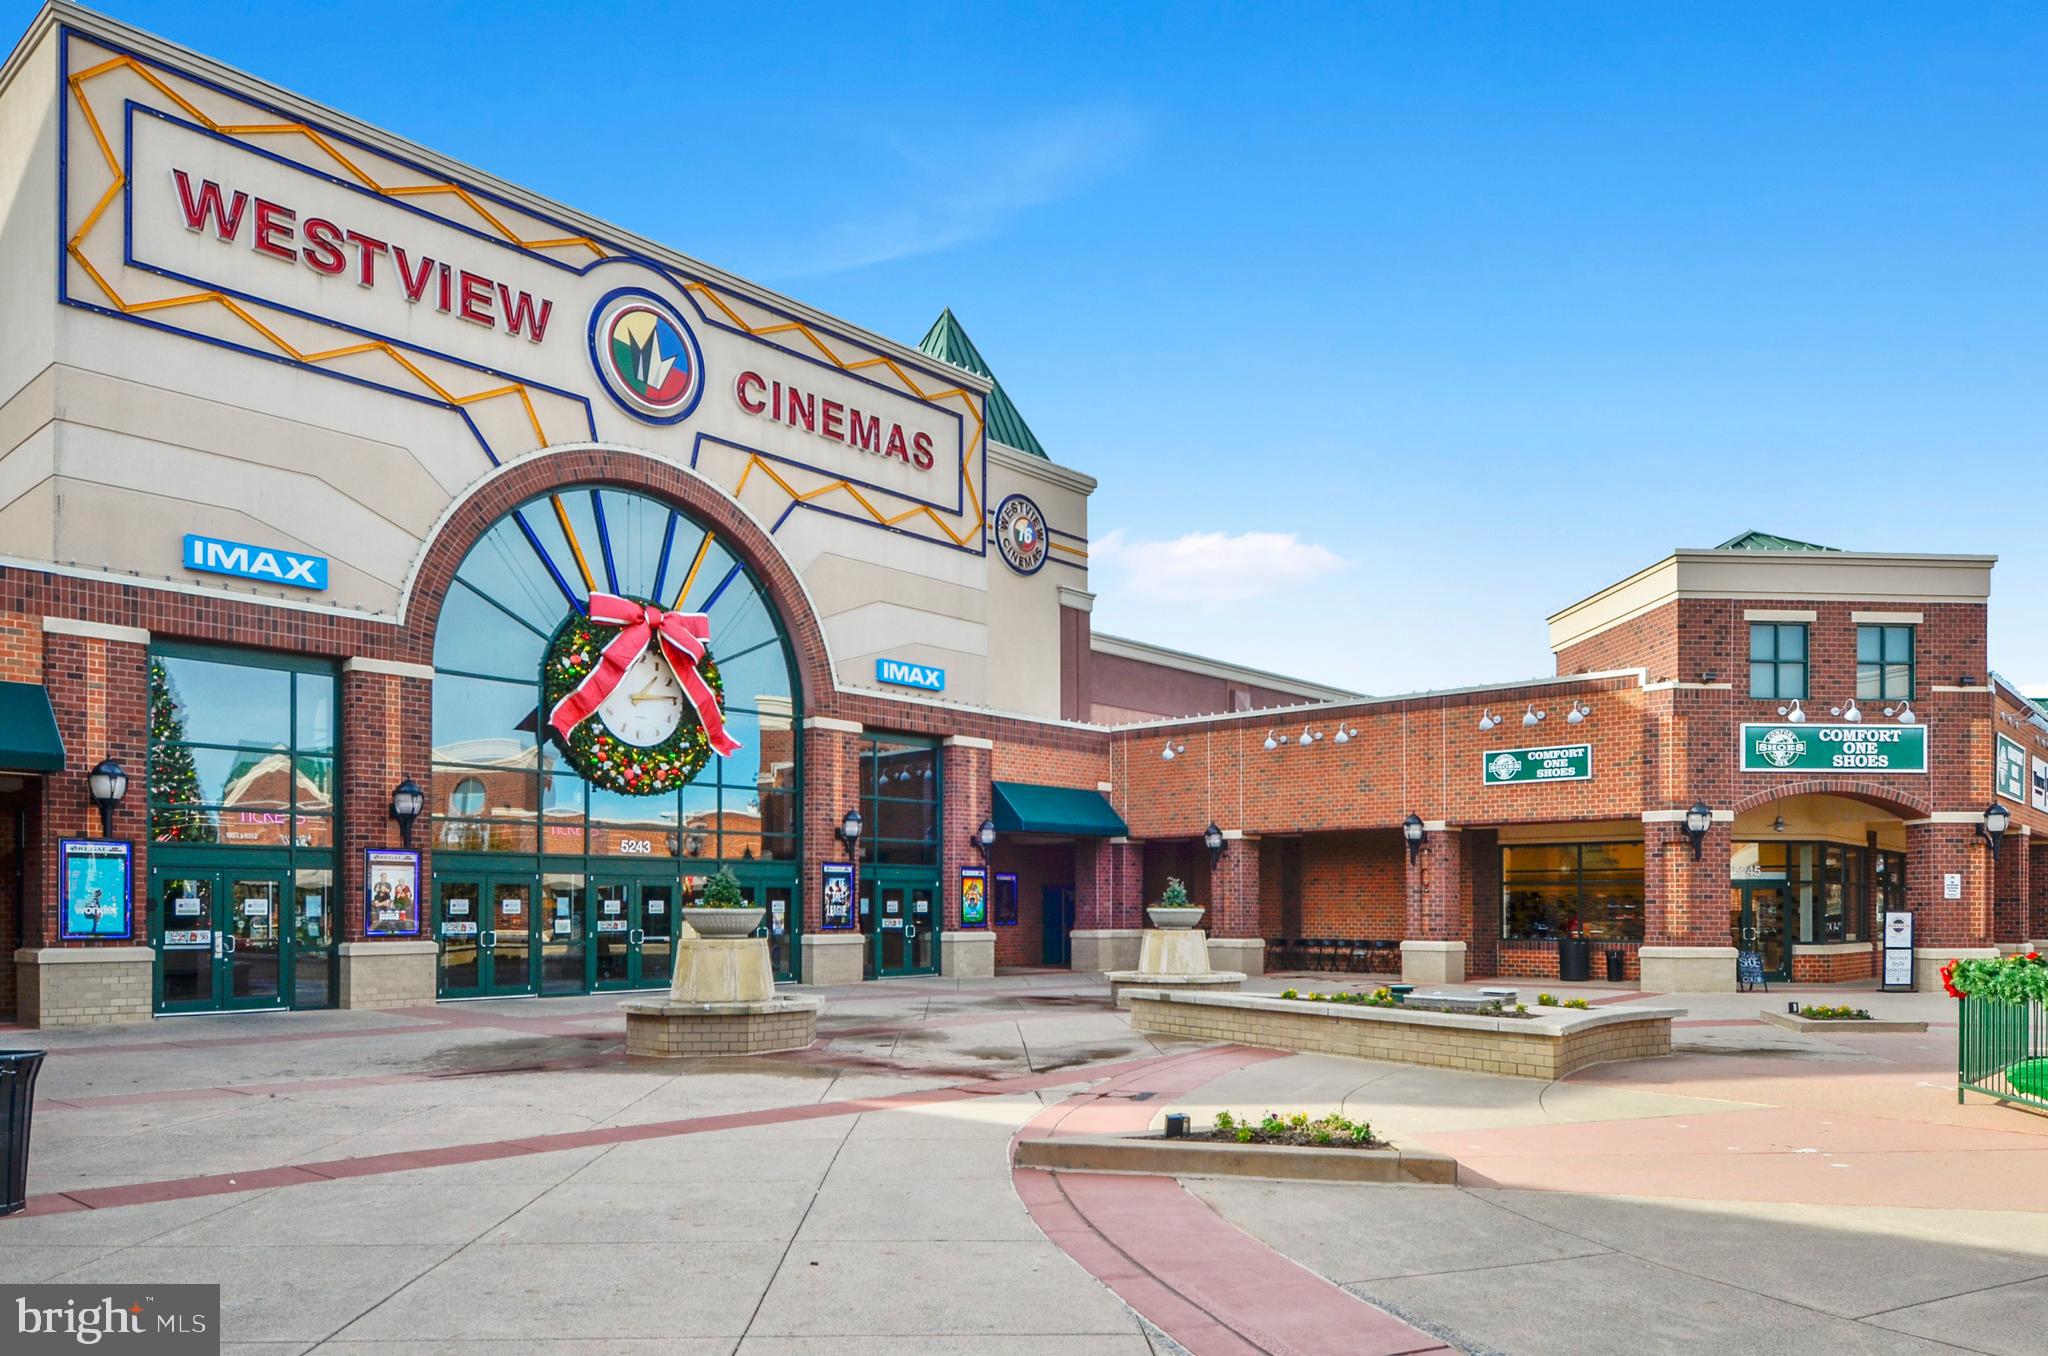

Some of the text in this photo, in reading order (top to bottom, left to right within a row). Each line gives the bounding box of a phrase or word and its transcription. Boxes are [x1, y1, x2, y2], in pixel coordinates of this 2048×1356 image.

[172, 168, 553, 343] WESTVIEW
[735, 371, 934, 471] CINEMAS
[1001, 501, 1044, 541] WESTVIEW
[1019, 526, 1033, 544] 16
[1002, 538, 1042, 568] CINEMAS
[194, 540, 317, 584] IMAX
[883, 661, 940, 687] IMAX
[1819, 729, 1901, 742] COMFORT
[1758, 743, 1805, 752] SHOES
[1842, 742, 1878, 754] ONE
[1527, 748, 1585, 761] COMFORT
[1832, 755, 1889, 767] SHOES
[1543, 758, 1568, 769] ONE
[1536, 767, 1576, 778] SHOES
[241, 812, 306, 825] TICKES
[620, 840, 651, 853] 5243
